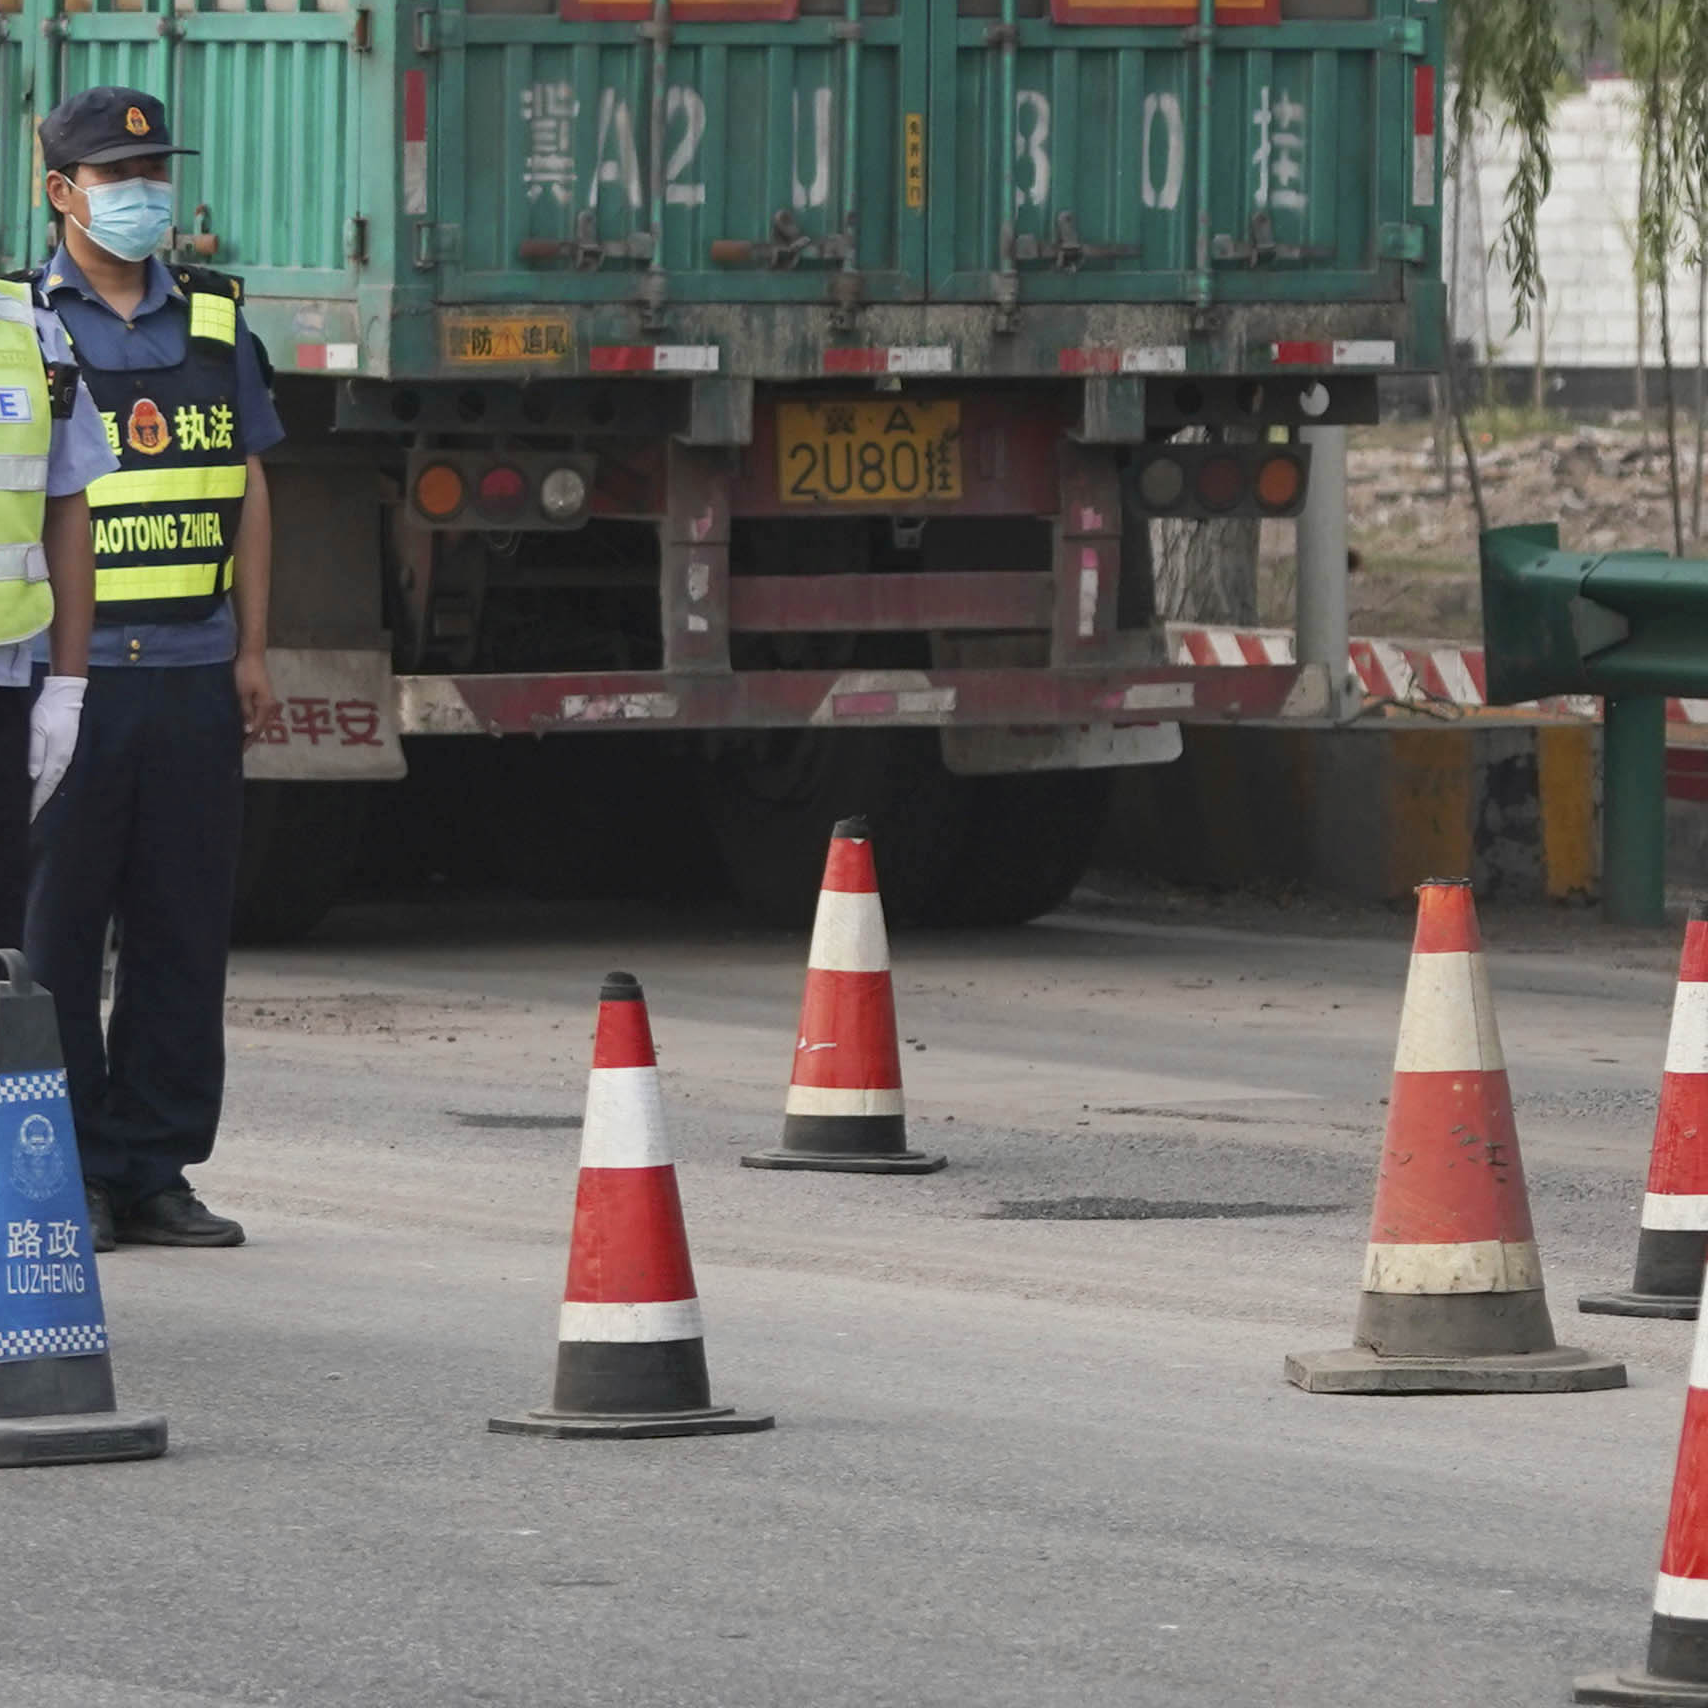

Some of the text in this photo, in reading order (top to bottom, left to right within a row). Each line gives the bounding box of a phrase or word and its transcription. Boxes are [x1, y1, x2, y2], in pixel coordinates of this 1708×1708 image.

[174, 404, 234, 451] 执法
[790, 440, 955, 495] 2U80挂
[91, 512, 224, 554] AOTONG ZHIFA
[6, 1219, 81, 1259] 路政
[6, 1263, 86, 1295] LUZHENG
